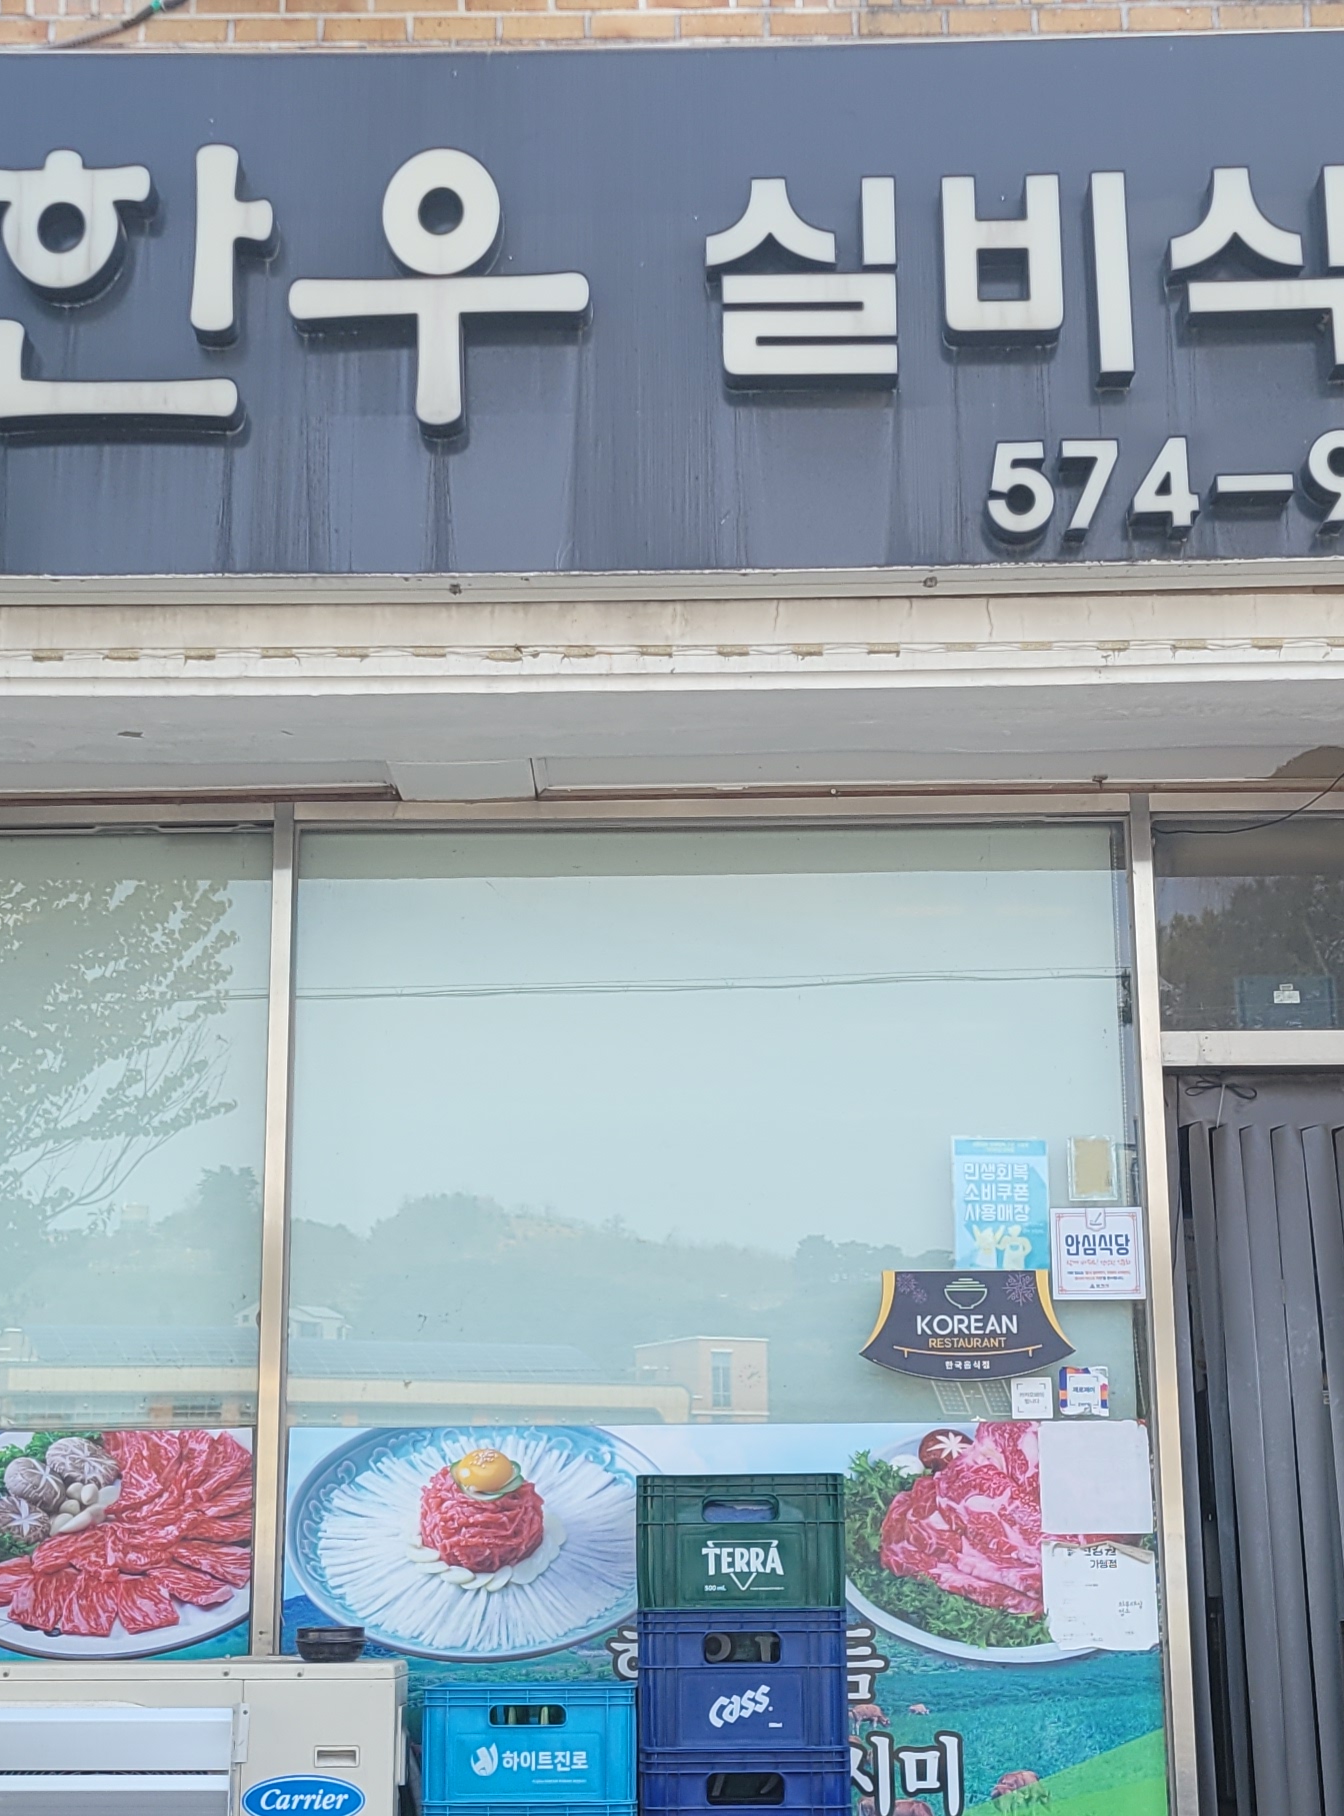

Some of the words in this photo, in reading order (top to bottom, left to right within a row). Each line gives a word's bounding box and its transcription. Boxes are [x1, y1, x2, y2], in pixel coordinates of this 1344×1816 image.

[964, 1162, 1029, 1181] 민생회복
[964, 1183, 1029, 1201] 소비쿠폰
[964, 1203, 1031, 1222] 사용매장
[1064, 1233, 1131, 1256] 안심식당
[916, 1314, 1018, 1335] KOREAN
[928, 1337, 1006, 1348] RESTAURANT
[945, 1360, 990, 1370] 한국음식점
[701, 1546, 785, 1576] TERRA
[1089, 1559, 1118, 1569] 가맹점
[501, 1750, 589, 1772] 하이트진로
[260, 1788, 349, 1810] Carrier
